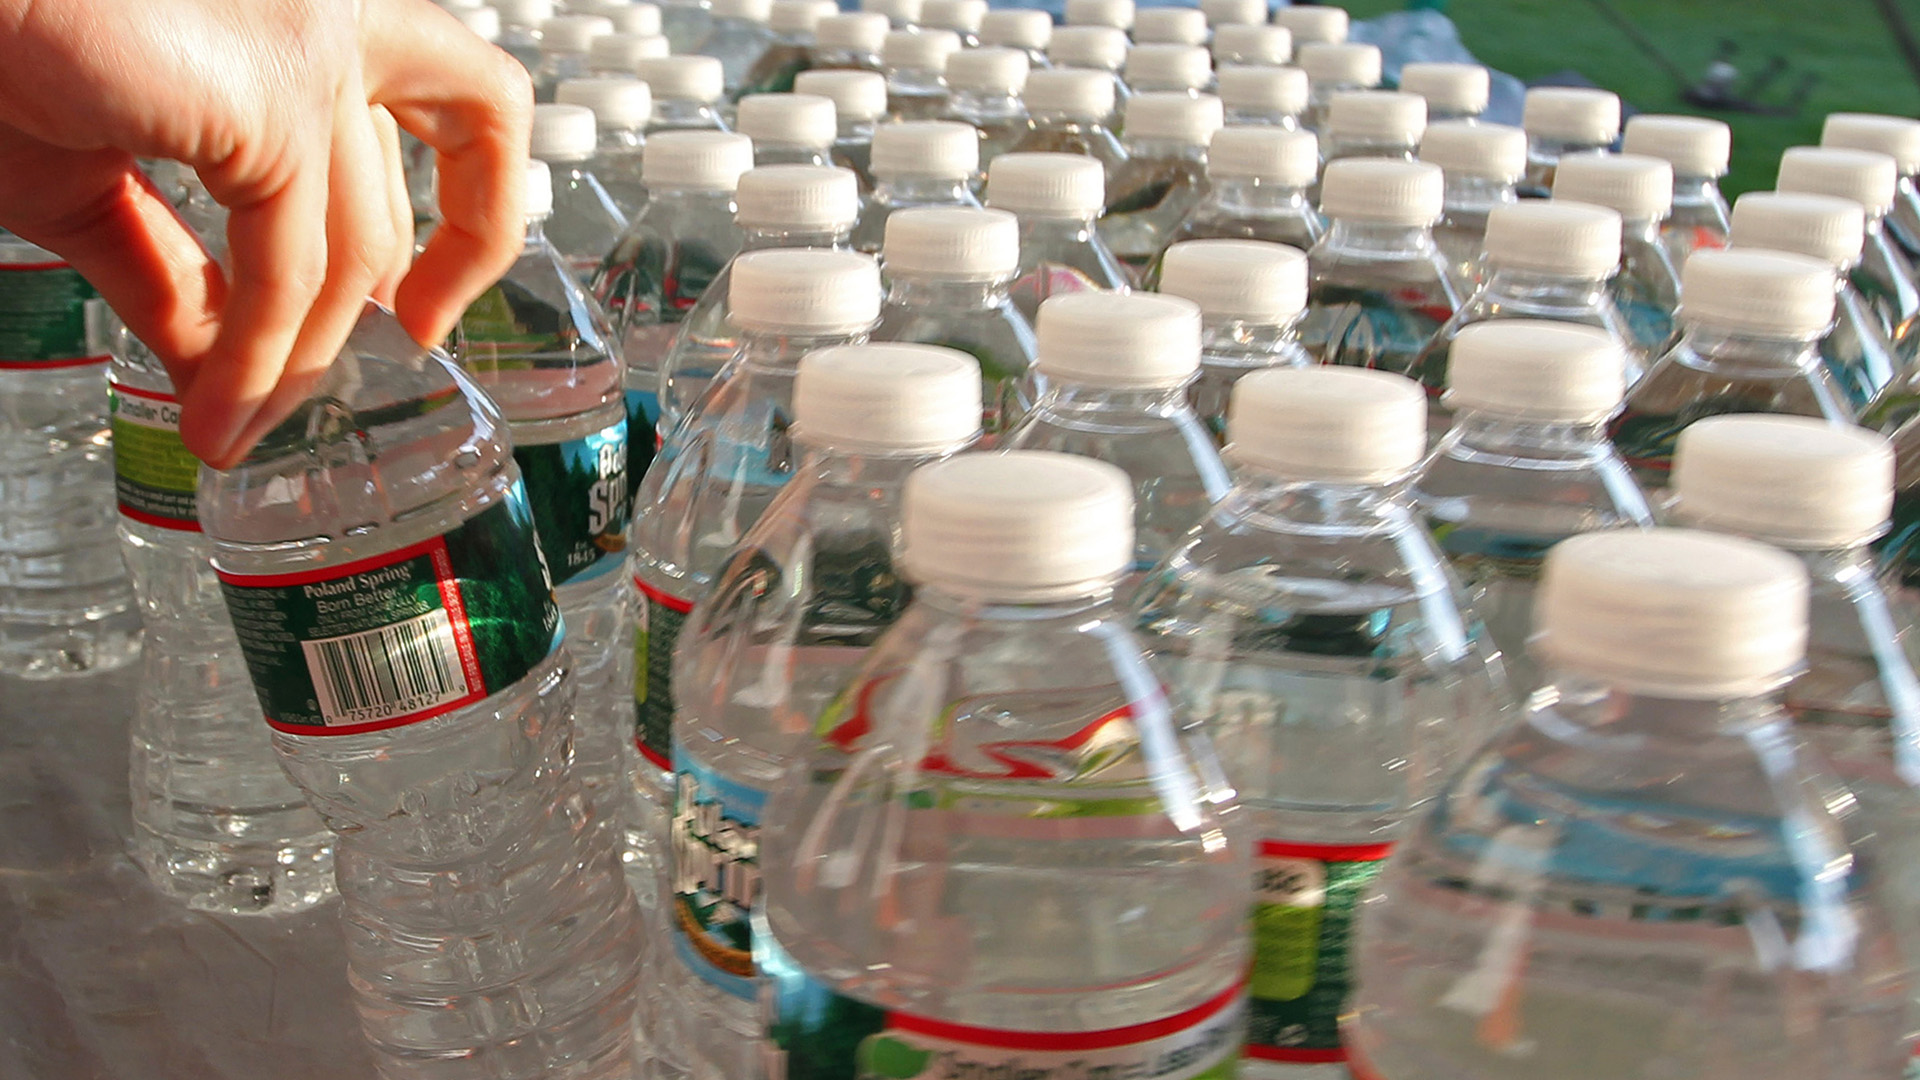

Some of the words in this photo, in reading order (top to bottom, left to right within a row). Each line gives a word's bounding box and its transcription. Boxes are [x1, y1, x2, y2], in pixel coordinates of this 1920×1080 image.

[161, 405, 179, 424] Ca
[303, 574, 356, 599] Poland
[316, 598, 351, 613] Born
[326, 714, 333, 724] 0
[350, 703, 392, 722] 75720
[399, 691, 441, 713] 48127
